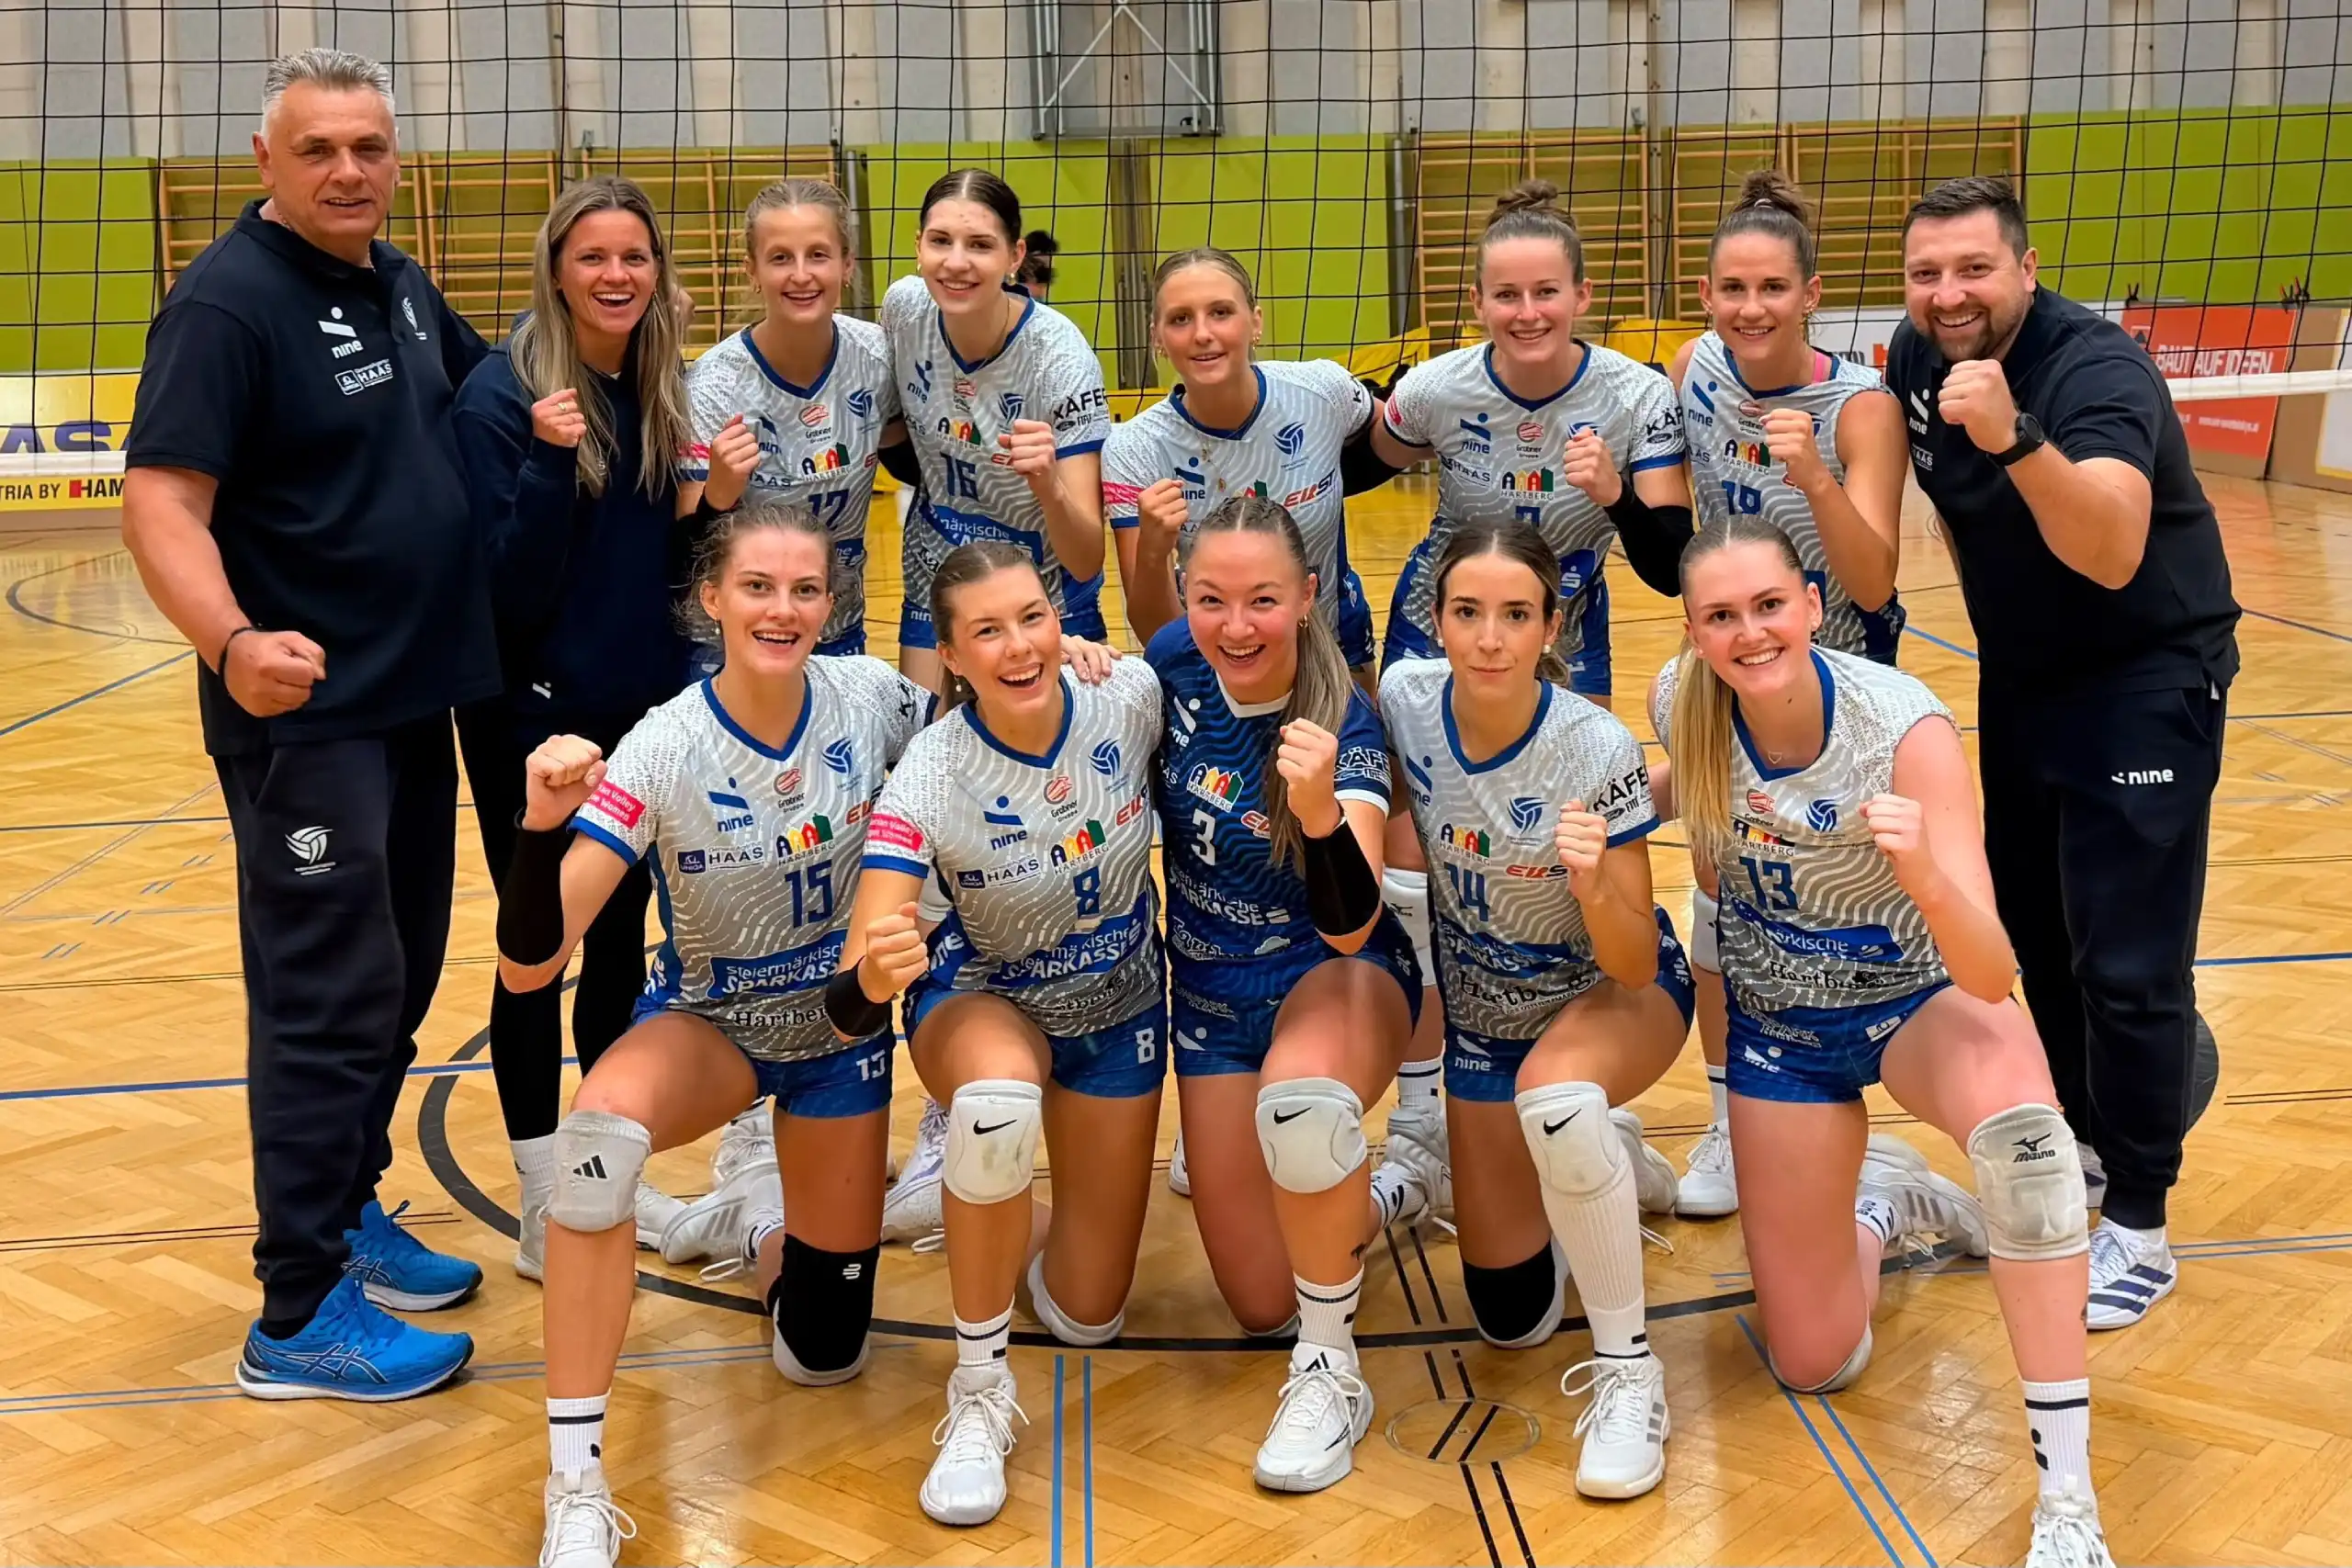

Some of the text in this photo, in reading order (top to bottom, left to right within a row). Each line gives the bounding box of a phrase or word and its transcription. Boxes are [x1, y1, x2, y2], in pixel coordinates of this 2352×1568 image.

[332, 340, 364, 358] nine
[357, 364, 392, 383] HAAS
[1689, 409, 1713, 427] nine
[1461, 441, 1490, 454] nine
[940, 450, 980, 502] 16
[40, 483, 61, 499] BY
[1500, 489, 1555, 502] HARTBERG
[2128, 768, 2174, 784] nine
[718, 814, 753, 833] nine
[990, 829, 1028, 851] nine
[1191, 808, 1216, 866] 3
[1733, 837, 1794, 857] HARTBERG
[708, 846, 763, 864] HAAS
[779, 840, 836, 866] HARTBERG
[1053, 844, 1110, 874] HARTBERG
[1439, 840, 1491, 867] HARTBERG
[987, 858, 1040, 883] HAAS
[785, 859, 833, 929] 15
[1073, 865, 1102, 920] 8
[1443, 861, 1490, 922] 14
[1738, 855, 1799, 911] 13
[1135, 1027, 1156, 1064] 8
[855, 1049, 887, 1082] 15
[1454, 1055, 1491, 1072] nine
